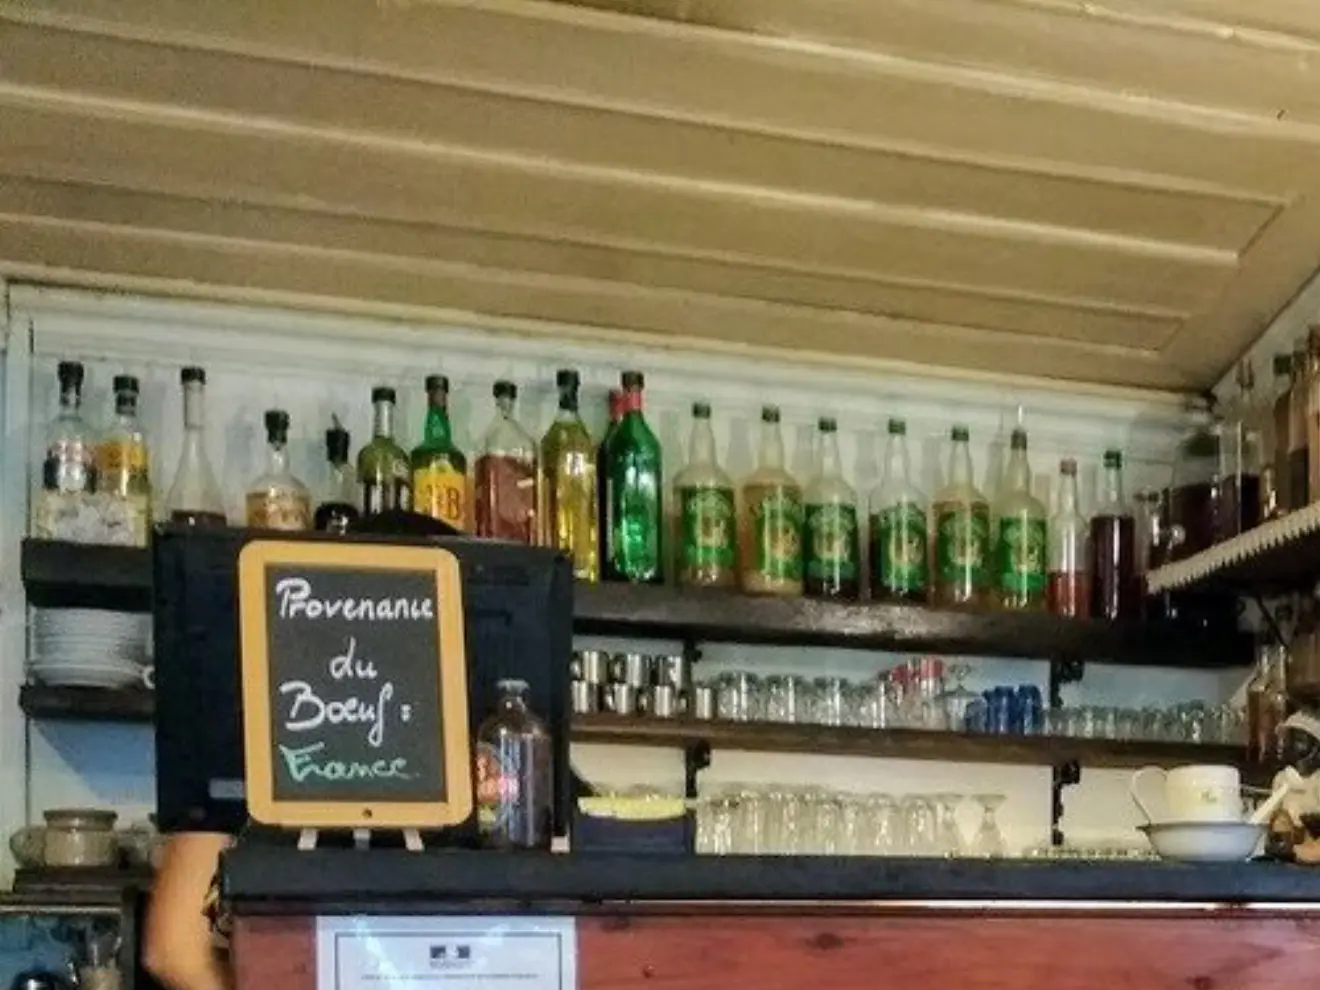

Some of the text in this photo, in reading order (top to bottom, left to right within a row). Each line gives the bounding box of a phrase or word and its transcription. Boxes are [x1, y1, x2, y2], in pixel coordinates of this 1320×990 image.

[275, 577, 434, 621] Provenance
[329, 636, 378, 679] du
[279, 741, 413, 781] France
